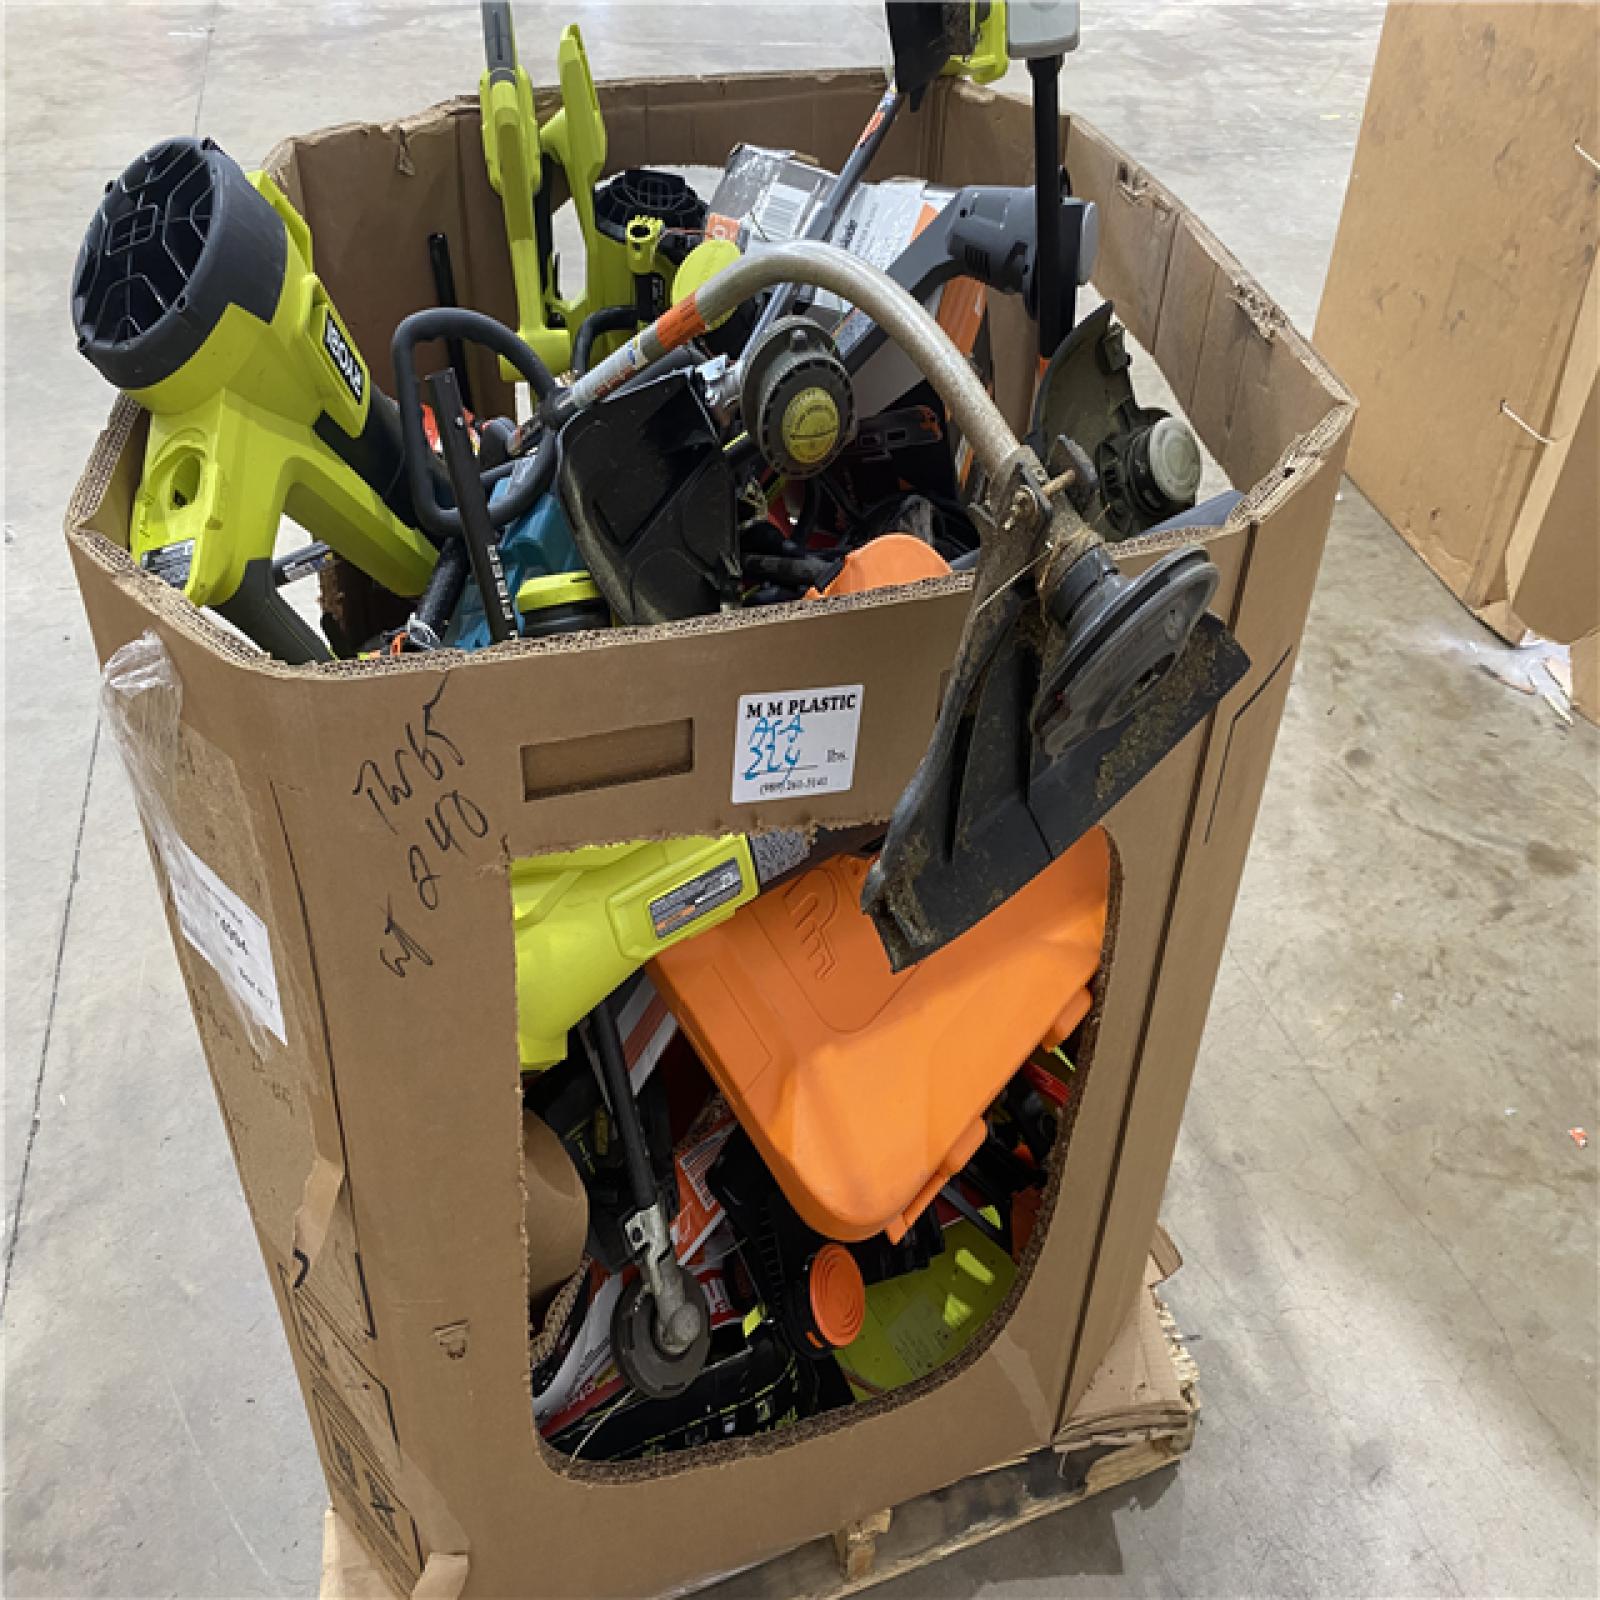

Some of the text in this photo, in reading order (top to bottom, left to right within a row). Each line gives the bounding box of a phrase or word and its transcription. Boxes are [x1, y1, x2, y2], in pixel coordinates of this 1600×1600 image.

[746, 693, 857, 720] M M PLASTIC
